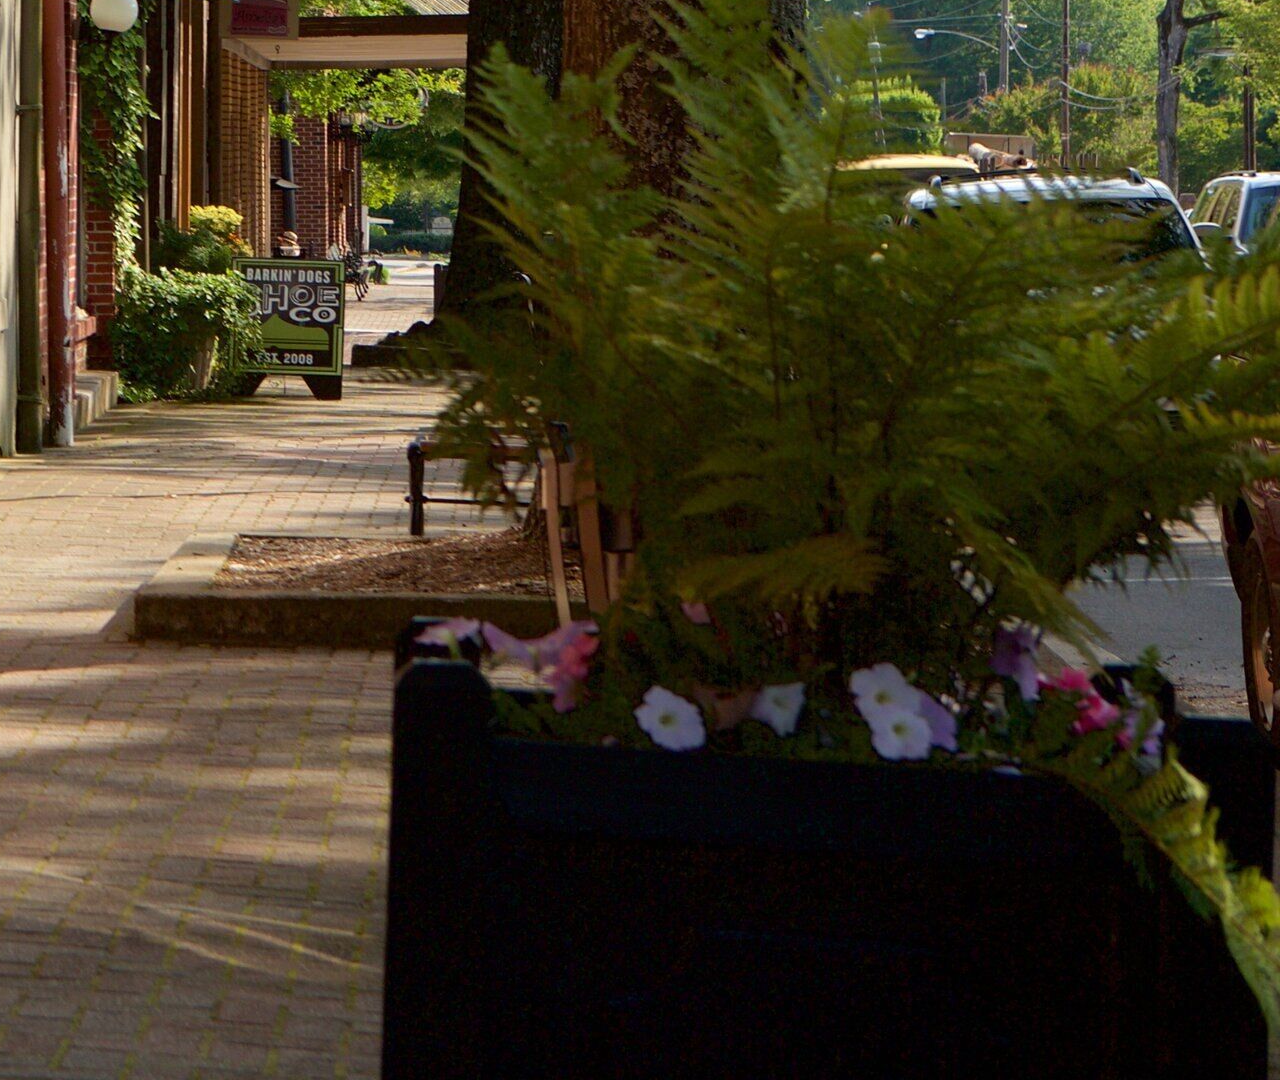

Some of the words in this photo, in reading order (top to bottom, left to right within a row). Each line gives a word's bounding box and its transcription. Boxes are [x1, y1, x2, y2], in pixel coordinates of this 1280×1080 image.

[246, 268, 297, 283] BARKIN'
[298, 269, 331, 283] DOGS
[289, 306, 337, 323] CO
[283, 352, 313, 365] 2008
